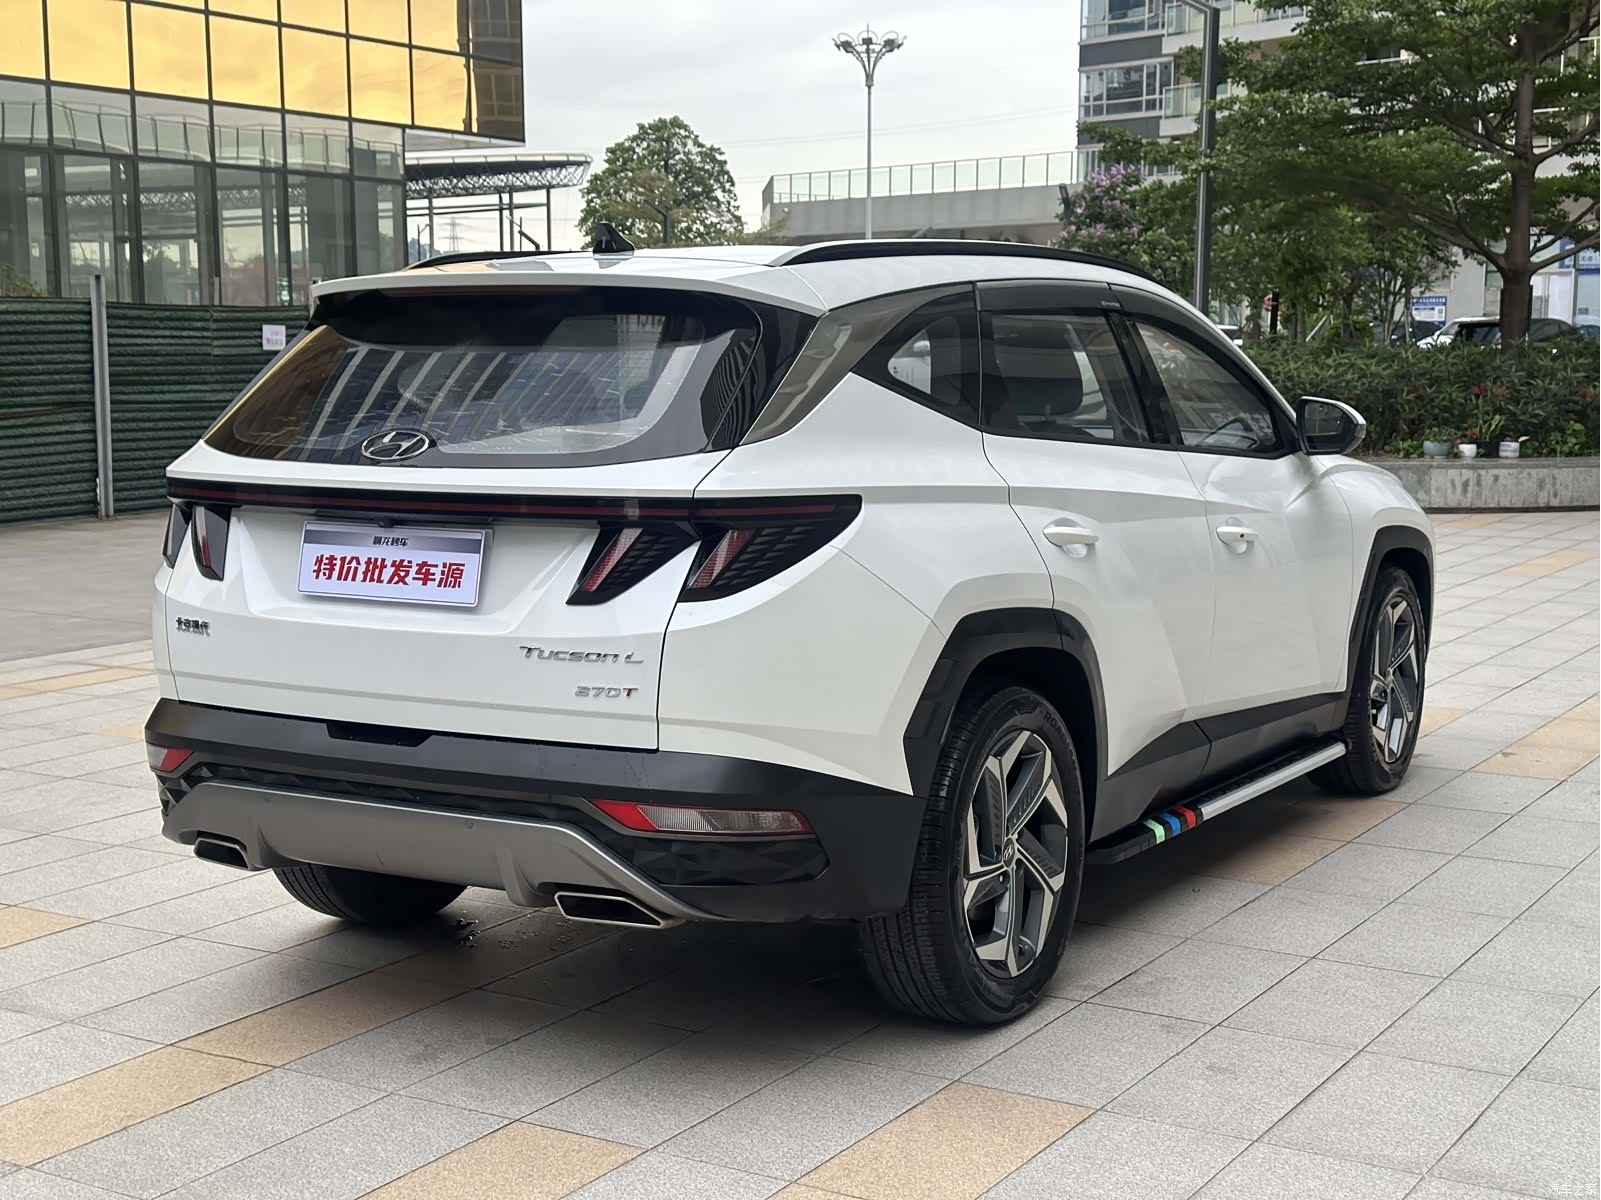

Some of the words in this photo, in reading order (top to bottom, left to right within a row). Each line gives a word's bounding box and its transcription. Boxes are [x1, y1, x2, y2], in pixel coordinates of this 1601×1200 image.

[312, 554, 466, 589] 特价批发车源
[624, 651, 644, 664] L
[574, 685, 639, 698] 270T
